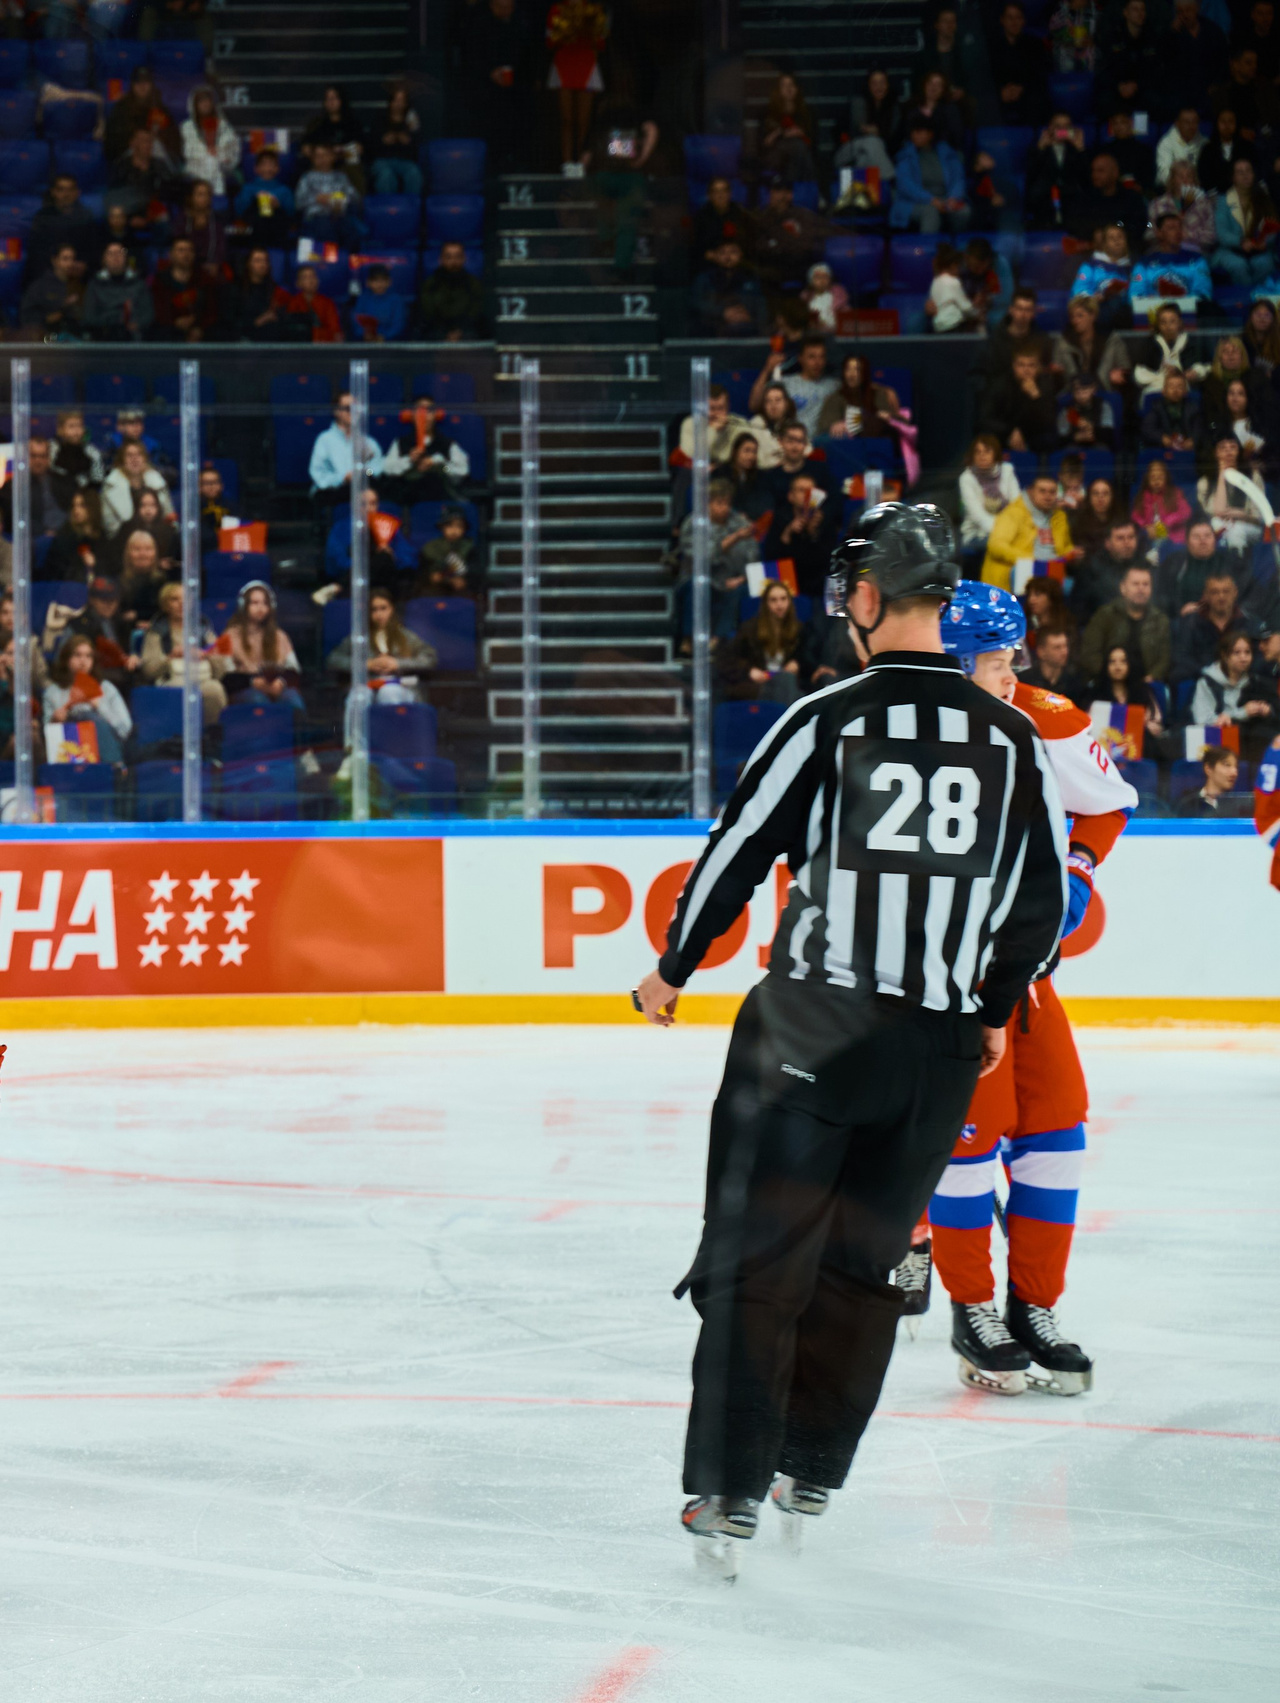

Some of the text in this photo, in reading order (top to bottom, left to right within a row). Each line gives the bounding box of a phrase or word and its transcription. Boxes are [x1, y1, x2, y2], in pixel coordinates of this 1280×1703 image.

[500, 238, 529, 260] 13
[499, 296, 527, 319] 12
[621, 293, 651, 317] 12
[625, 353, 650, 379] 11
[866, 762, 982, 856] 28
